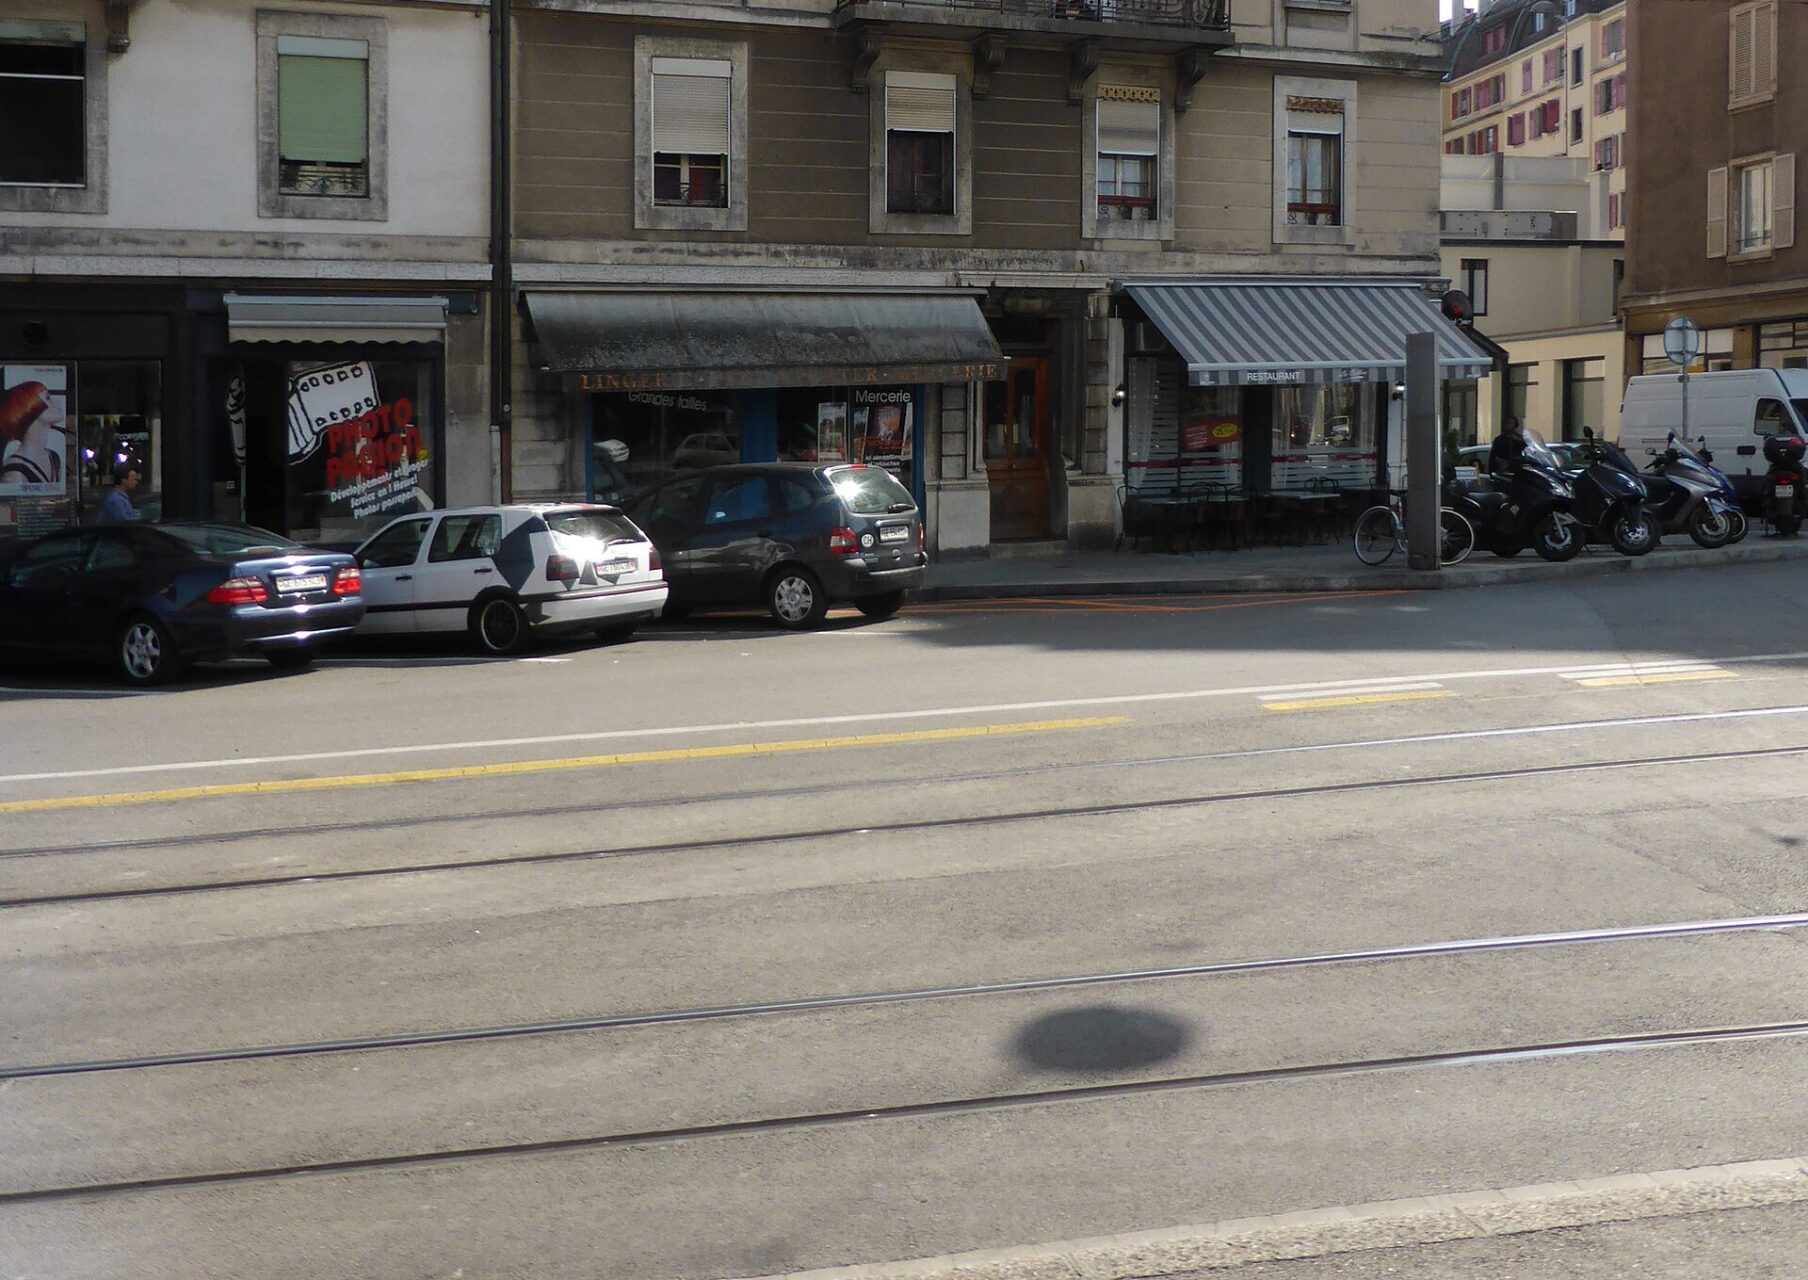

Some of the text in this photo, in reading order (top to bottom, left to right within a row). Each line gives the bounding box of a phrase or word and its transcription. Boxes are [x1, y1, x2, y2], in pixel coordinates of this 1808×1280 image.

[1247, 371, 1300, 382] RESTAURANT
[628, 390, 708, 411] Grandes tailles
[855, 389, 911, 404] Mercerie
[327, 397, 413, 454] PHOTO
[350, 491, 376, 509] Service
